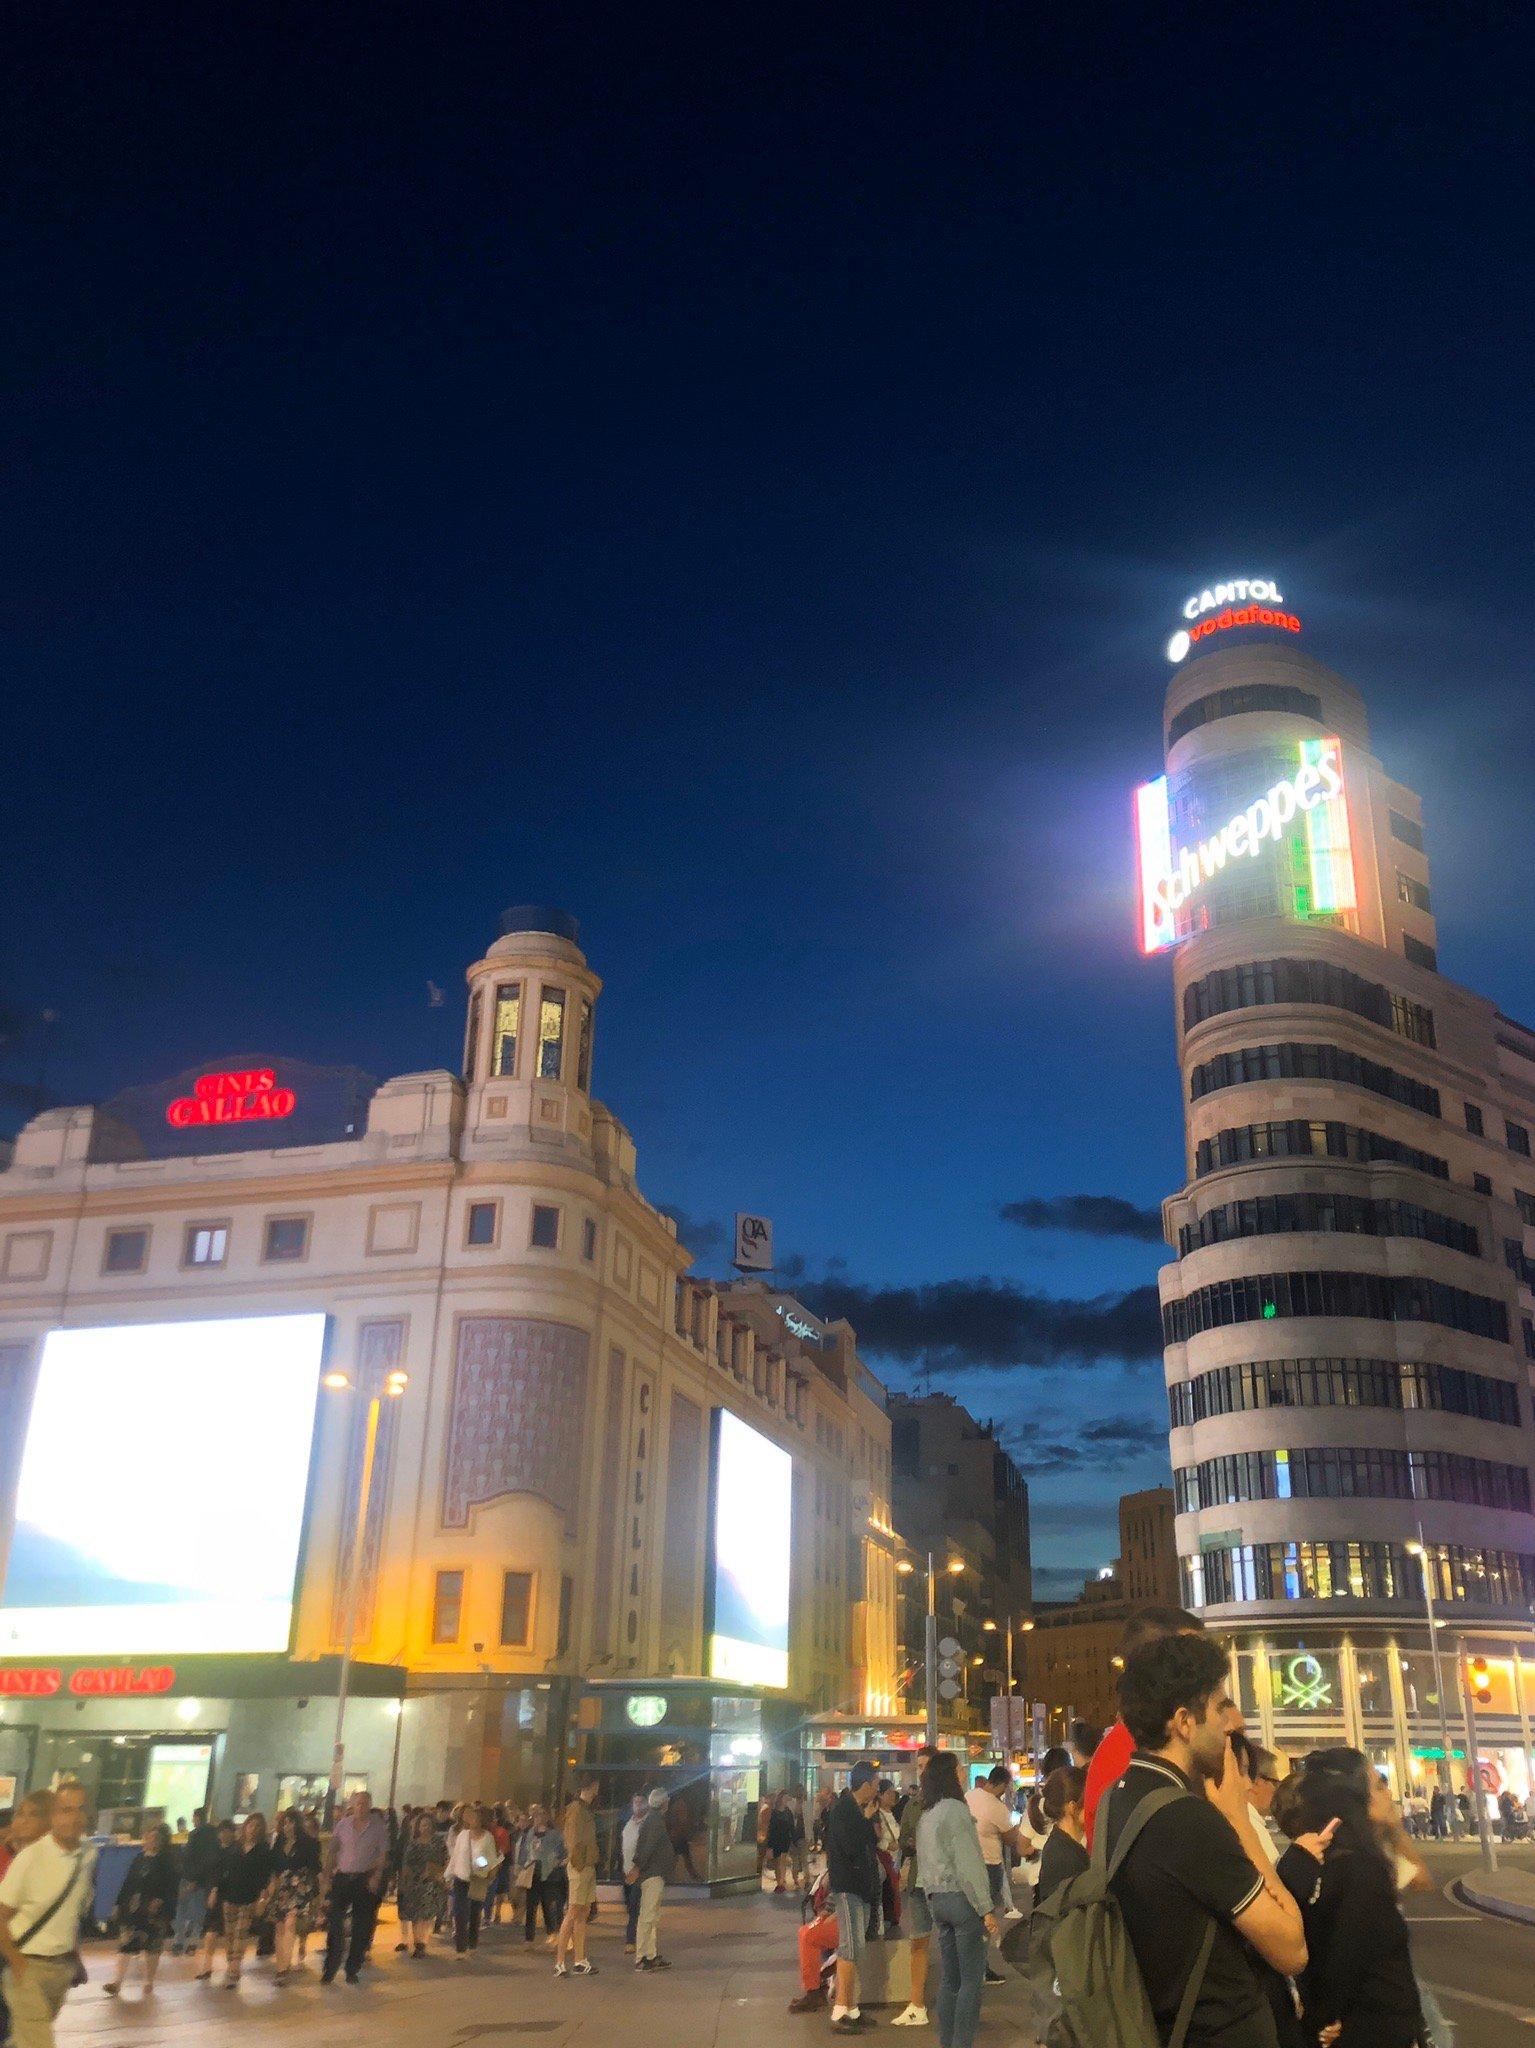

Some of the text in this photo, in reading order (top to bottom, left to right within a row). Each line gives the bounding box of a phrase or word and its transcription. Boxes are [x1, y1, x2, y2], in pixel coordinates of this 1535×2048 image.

[1184, 579, 1284, 619] CAPITOL
[1189, 602, 1301, 641] vodafone
[1144, 749, 1342, 931] Schweppes
[167, 1088, 296, 1129] CALLAO
[627, 1382, 650, 1644] CALLAO
[0, 1668, 61, 1696] INES
